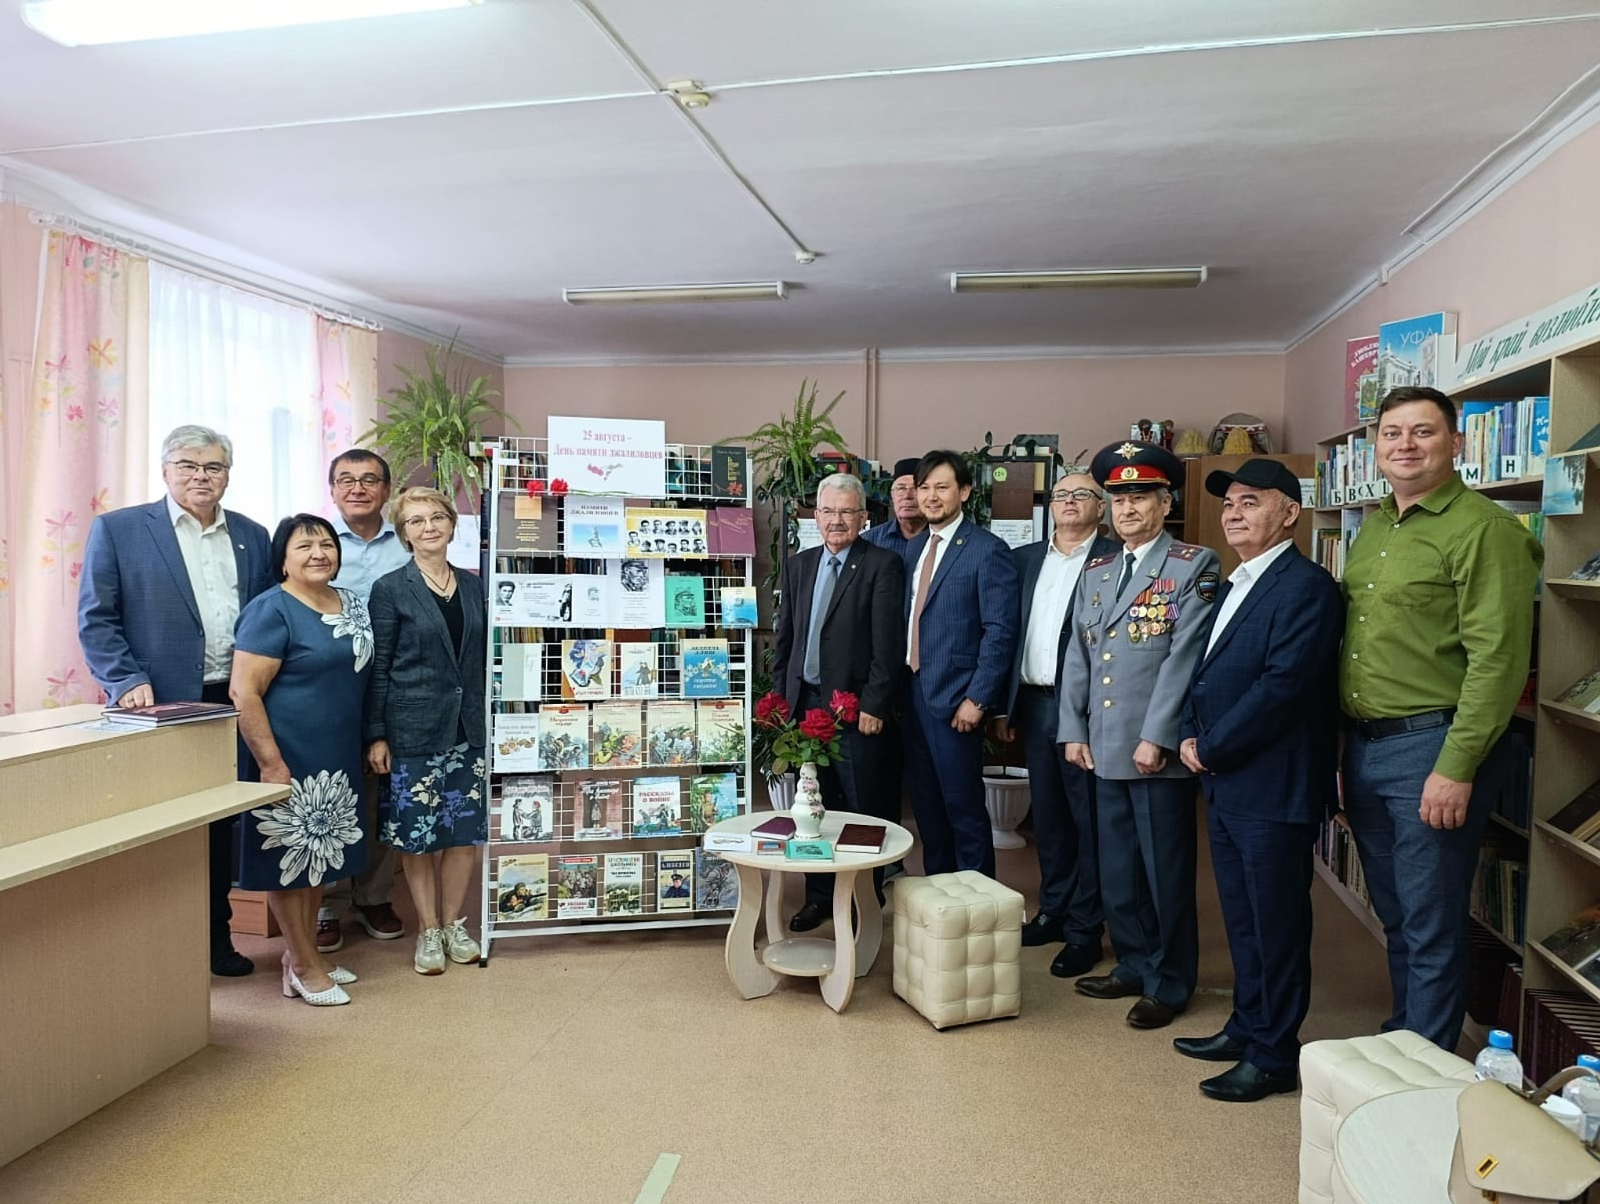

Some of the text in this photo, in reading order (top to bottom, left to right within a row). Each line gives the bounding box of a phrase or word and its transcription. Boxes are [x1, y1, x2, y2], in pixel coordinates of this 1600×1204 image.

[583, 430, 592, 441] 25
[594, 433, 625, 444] августа
[553, 444, 575, 456] День
[576, 447, 607, 457] памяти
[1506, 459, 1515, 473] Н
[1466, 467, 1478, 479] М
[1334, 491, 1341, 504] Б
[1349, 488, 1356, 501] В
